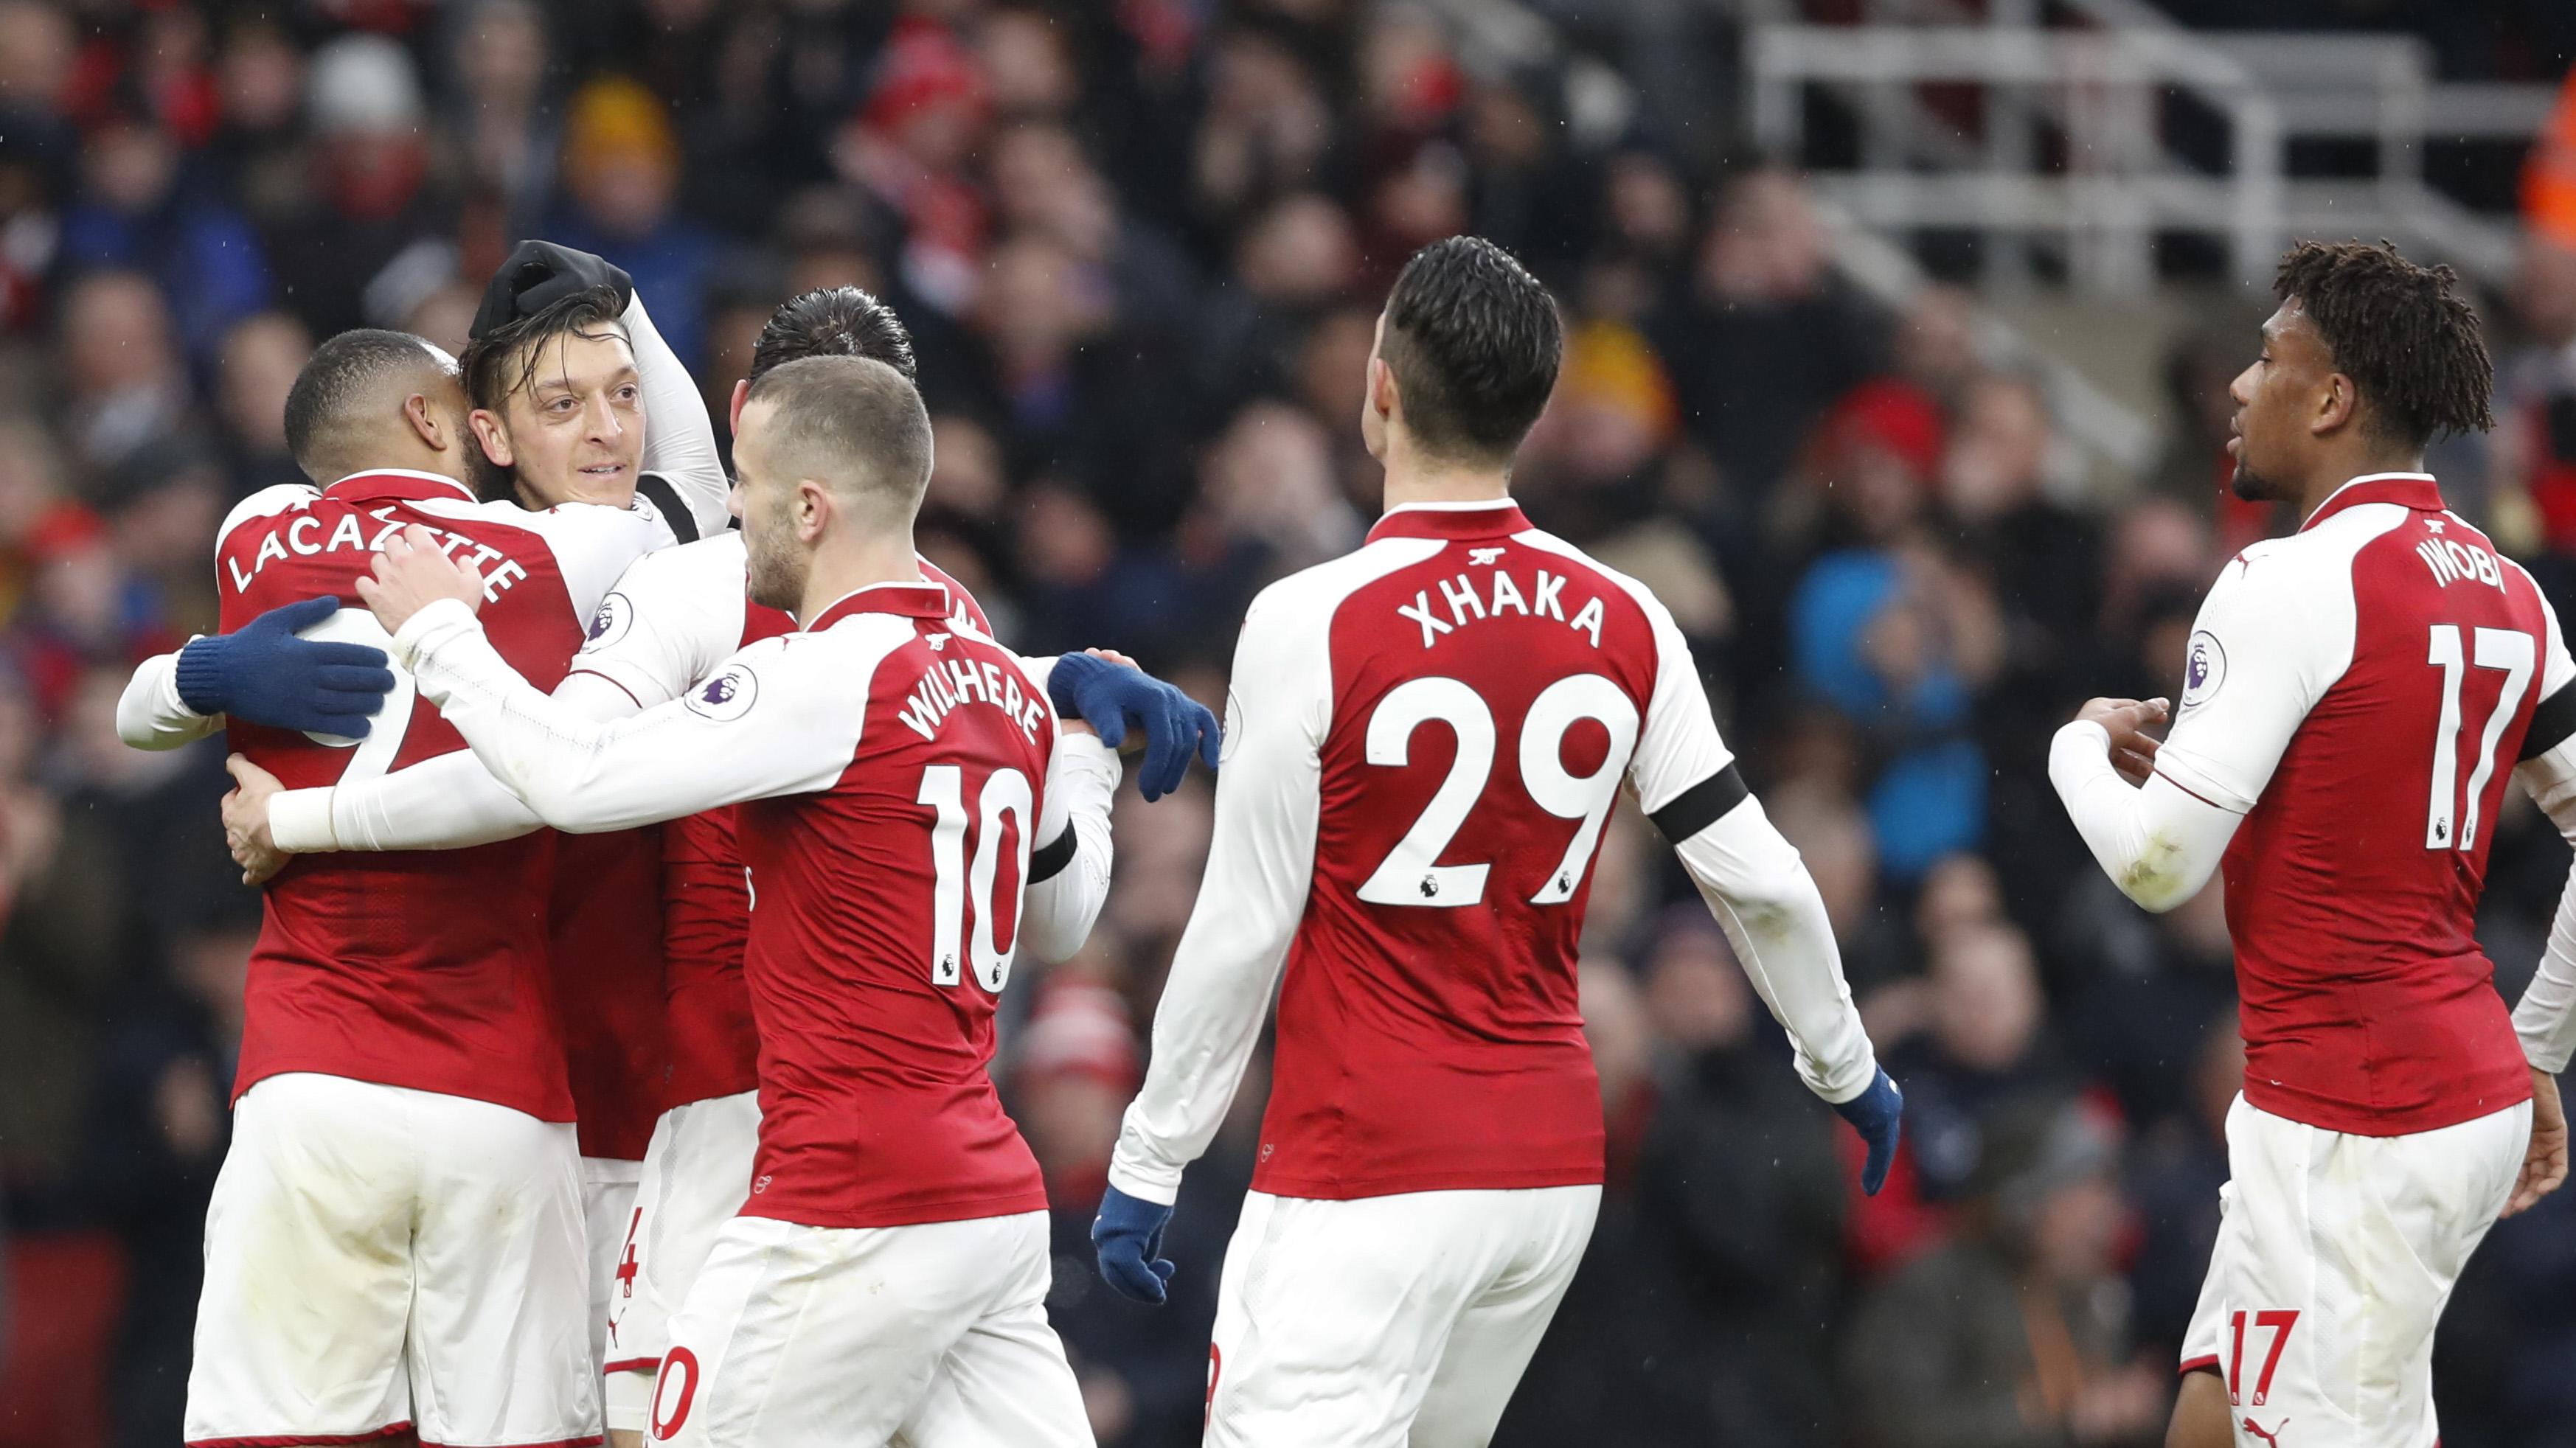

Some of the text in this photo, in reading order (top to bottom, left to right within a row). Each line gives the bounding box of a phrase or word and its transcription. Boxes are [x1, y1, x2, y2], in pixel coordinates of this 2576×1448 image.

[227, 505, 527, 605] LACAZTTE
[2415, 537, 2507, 596] IWOBI
[1397, 569, 1605, 649] XHAKA
[2426, 623, 2535, 851] 17
[1355, 672, 1641, 907] 29
[916, 764, 1034, 994] 10
[2229, 1309, 2302, 1406] 17
